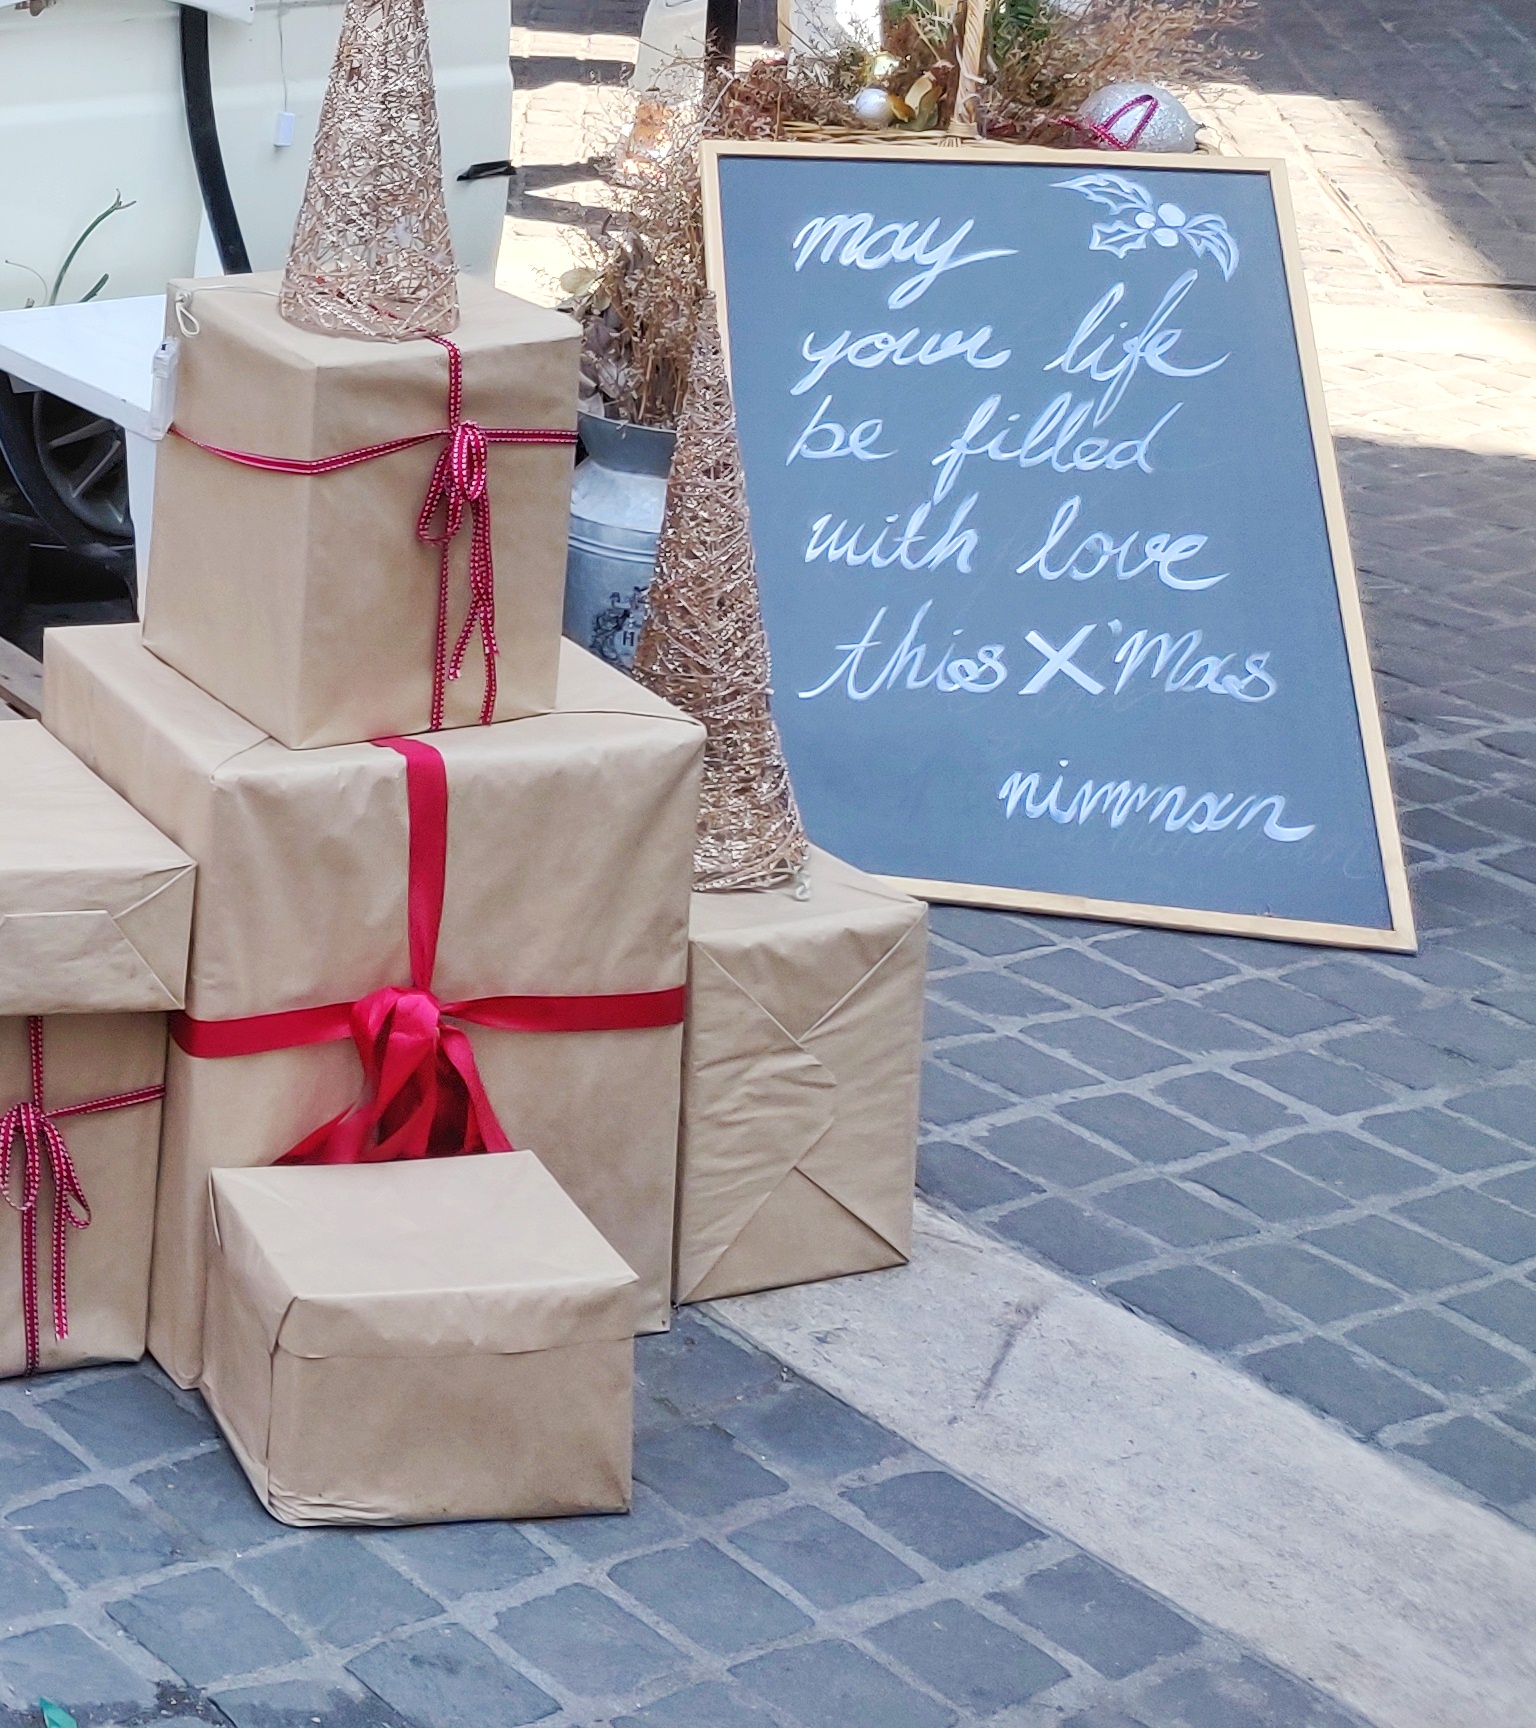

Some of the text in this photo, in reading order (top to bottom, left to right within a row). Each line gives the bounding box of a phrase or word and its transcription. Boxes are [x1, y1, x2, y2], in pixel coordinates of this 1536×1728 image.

[793, 212, 1018, 309] may
[789, 269, 1233, 426] your life
[785, 390, 1185, 507] be filled
[803, 492, 1233, 591] with love
[797, 598, 1009, 702] this
